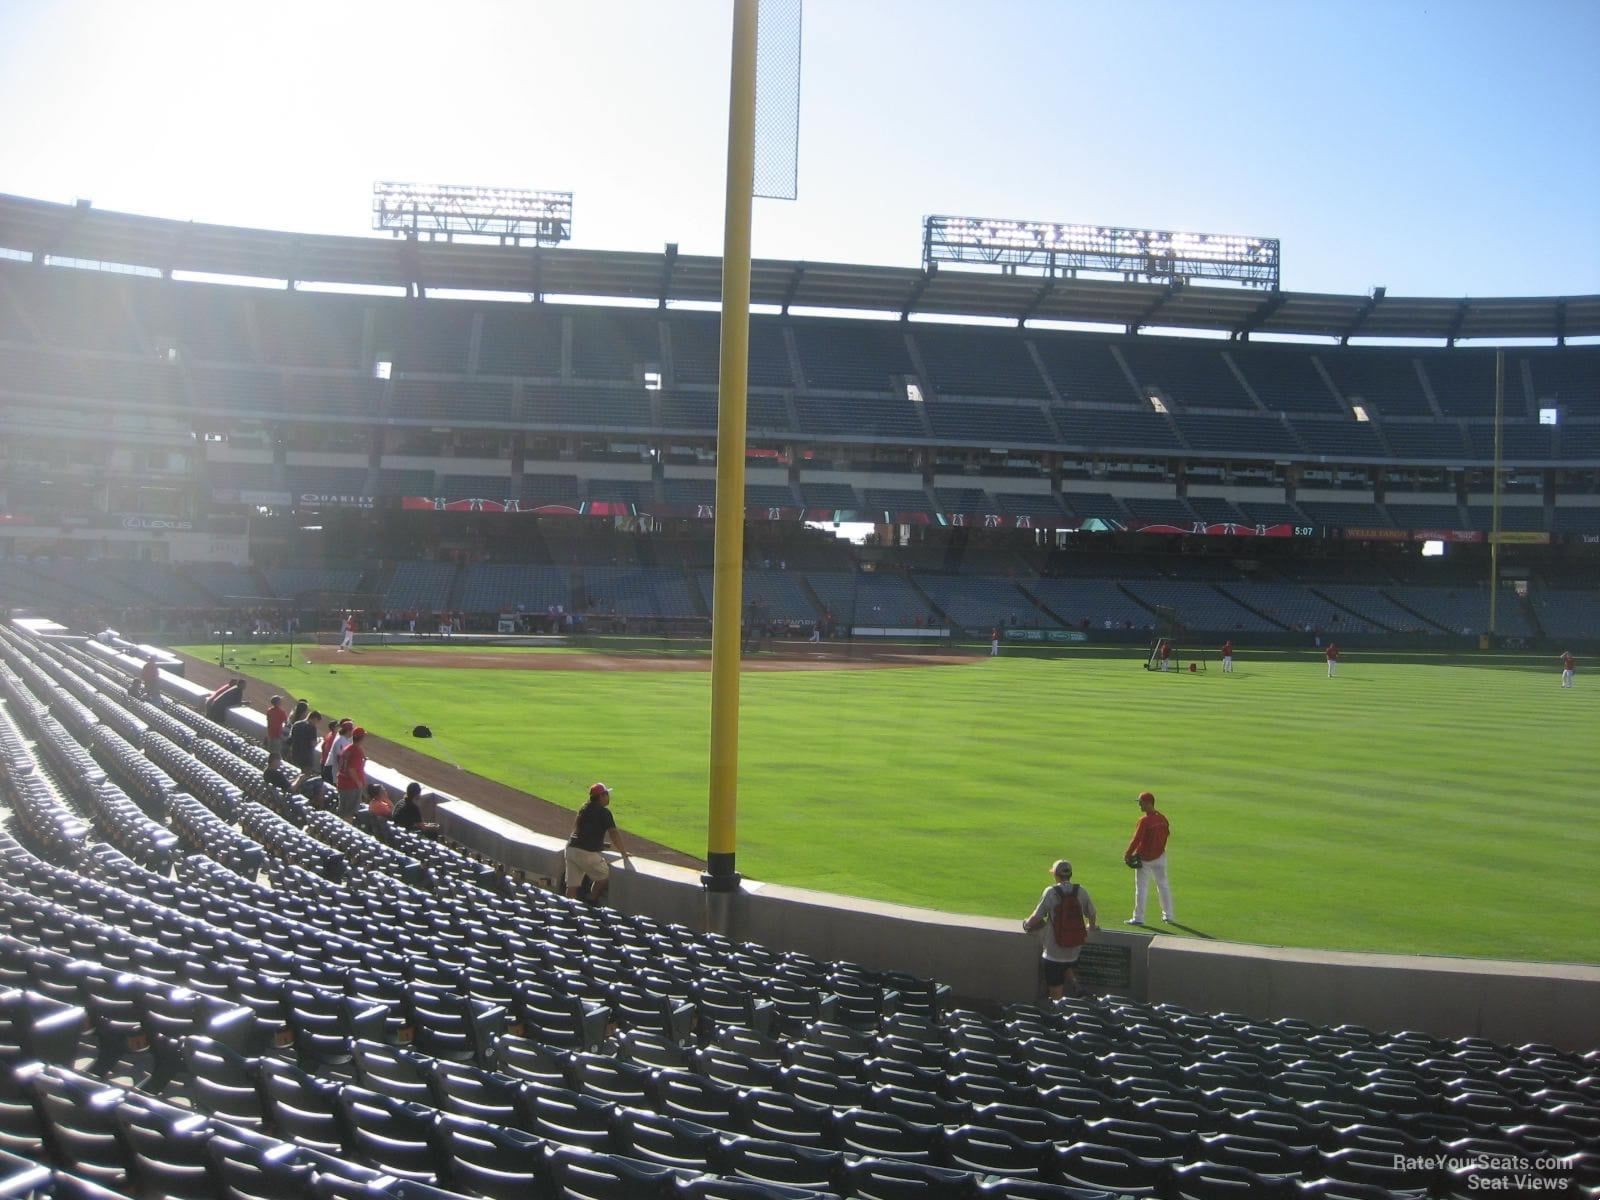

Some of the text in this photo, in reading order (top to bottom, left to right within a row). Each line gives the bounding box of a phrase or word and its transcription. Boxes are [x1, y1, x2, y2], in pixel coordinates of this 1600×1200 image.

[321, 495, 374, 503] OAKLEY
[142, 520, 192, 529] LEXUS
[1294, 526, 1313, 536] 5:07
